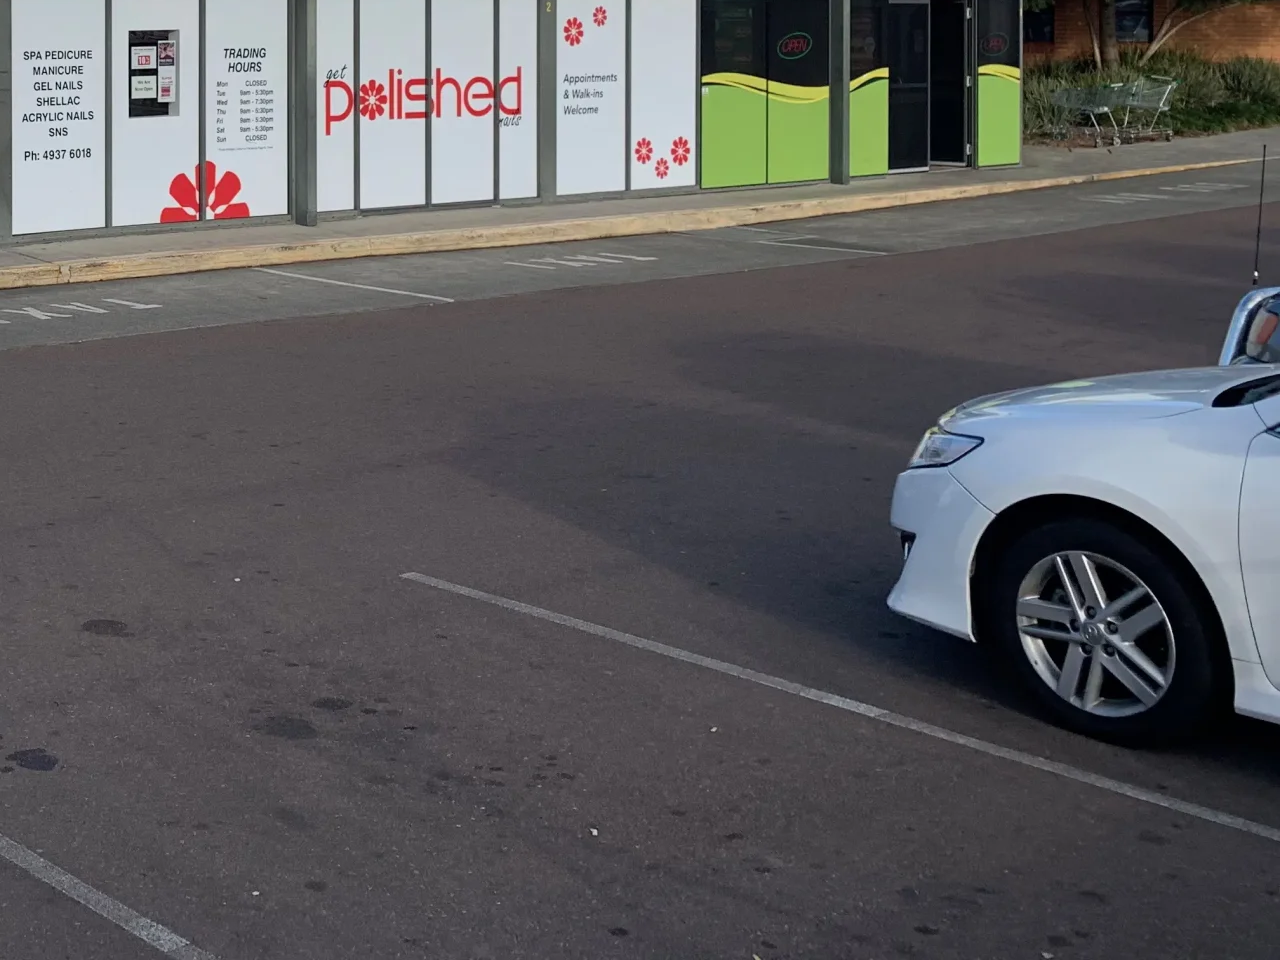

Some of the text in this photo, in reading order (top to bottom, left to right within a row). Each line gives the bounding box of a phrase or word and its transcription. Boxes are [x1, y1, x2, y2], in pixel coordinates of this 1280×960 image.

[546, 1, 552, 12] 2
[23, 50, 93, 60] SPA PEDICURE
[223, 47, 267, 59] TRADING
[32, 65, 84, 76] MANICURE
[227, 61, 262, 73] HOURS
[323, 64, 348, 88] get
[563, 73, 618, 86] Appointments
[33, 80, 83, 91] GEL NAILS
[563, 89, 604, 100] & Walk-ins
[36, 96, 81, 107] SHELLAC
[255, 98, 274, 106] 7:30pm
[563, 104, 599, 115] Welcome
[22, 111, 94, 123] ACRYLIC NAILS
[48, 127, 69, 137] SNS
[24, 148, 92, 161] Ph: 4937 6018
